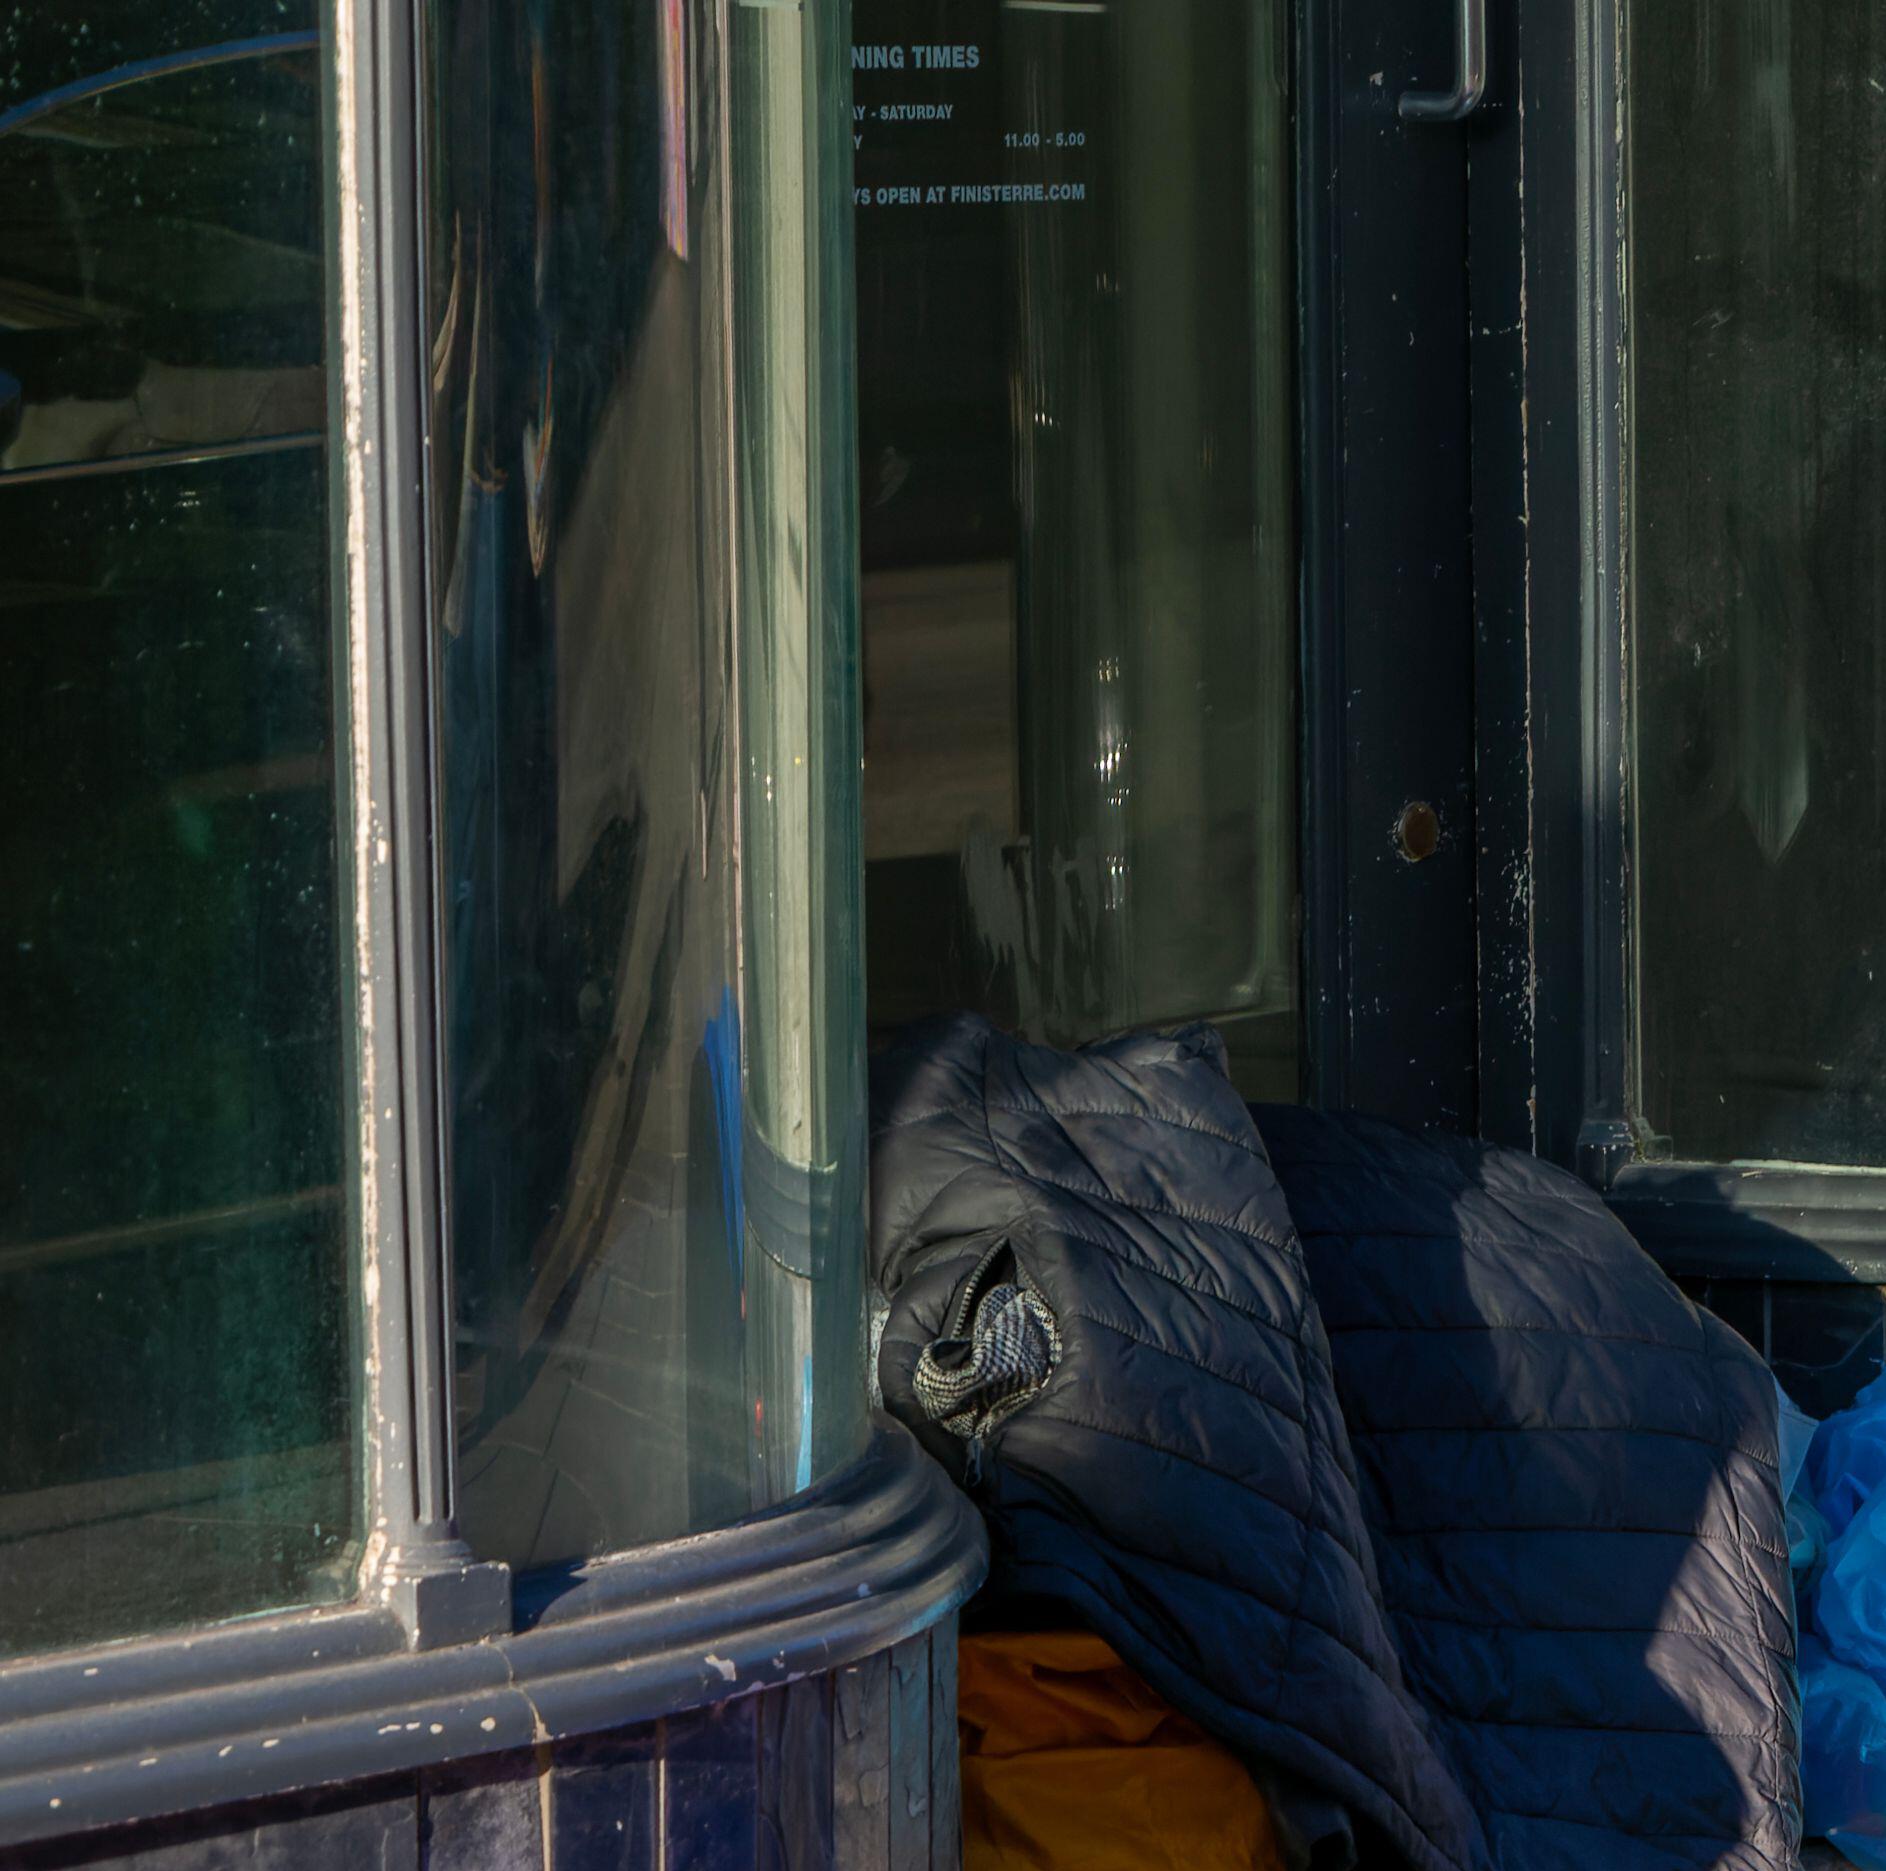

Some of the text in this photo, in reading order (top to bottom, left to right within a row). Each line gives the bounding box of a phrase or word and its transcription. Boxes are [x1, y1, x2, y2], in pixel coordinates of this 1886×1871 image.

[912, 46, 980, 69] TIMES
[880, 104, 953, 120] SATURDAY
[1004, 133, 1040, 148] 11.00
[876, 186, 921, 205] OPEN
[926, 186, 946, 204] AT
[951, 184, 1086, 203] FINISTERRE.COM
